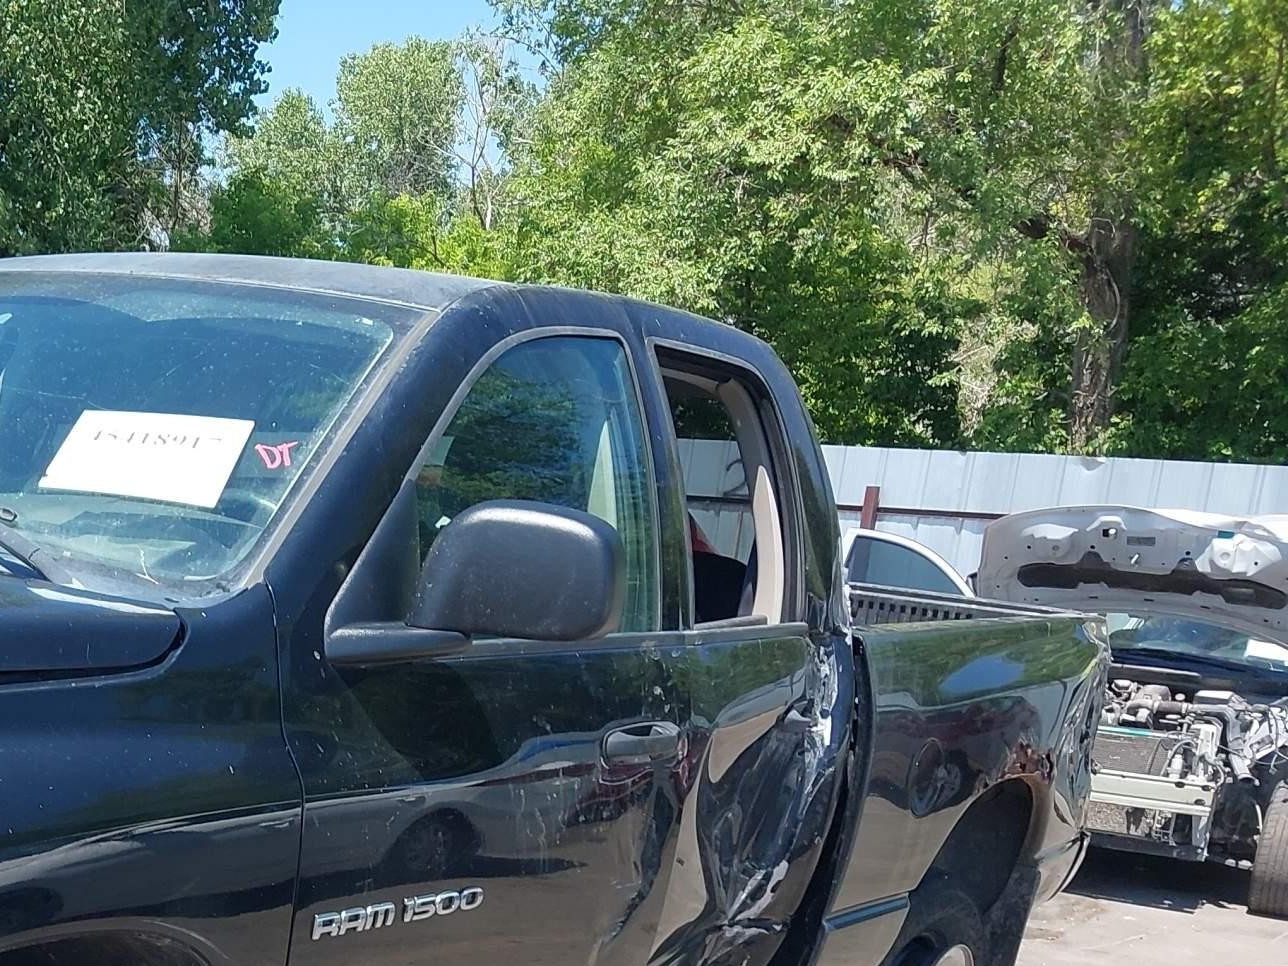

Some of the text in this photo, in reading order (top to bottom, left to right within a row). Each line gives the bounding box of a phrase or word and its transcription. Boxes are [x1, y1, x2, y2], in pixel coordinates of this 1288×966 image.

[255, 441, 298, 469] DT
[312, 887, 484, 940] RAM 1500
